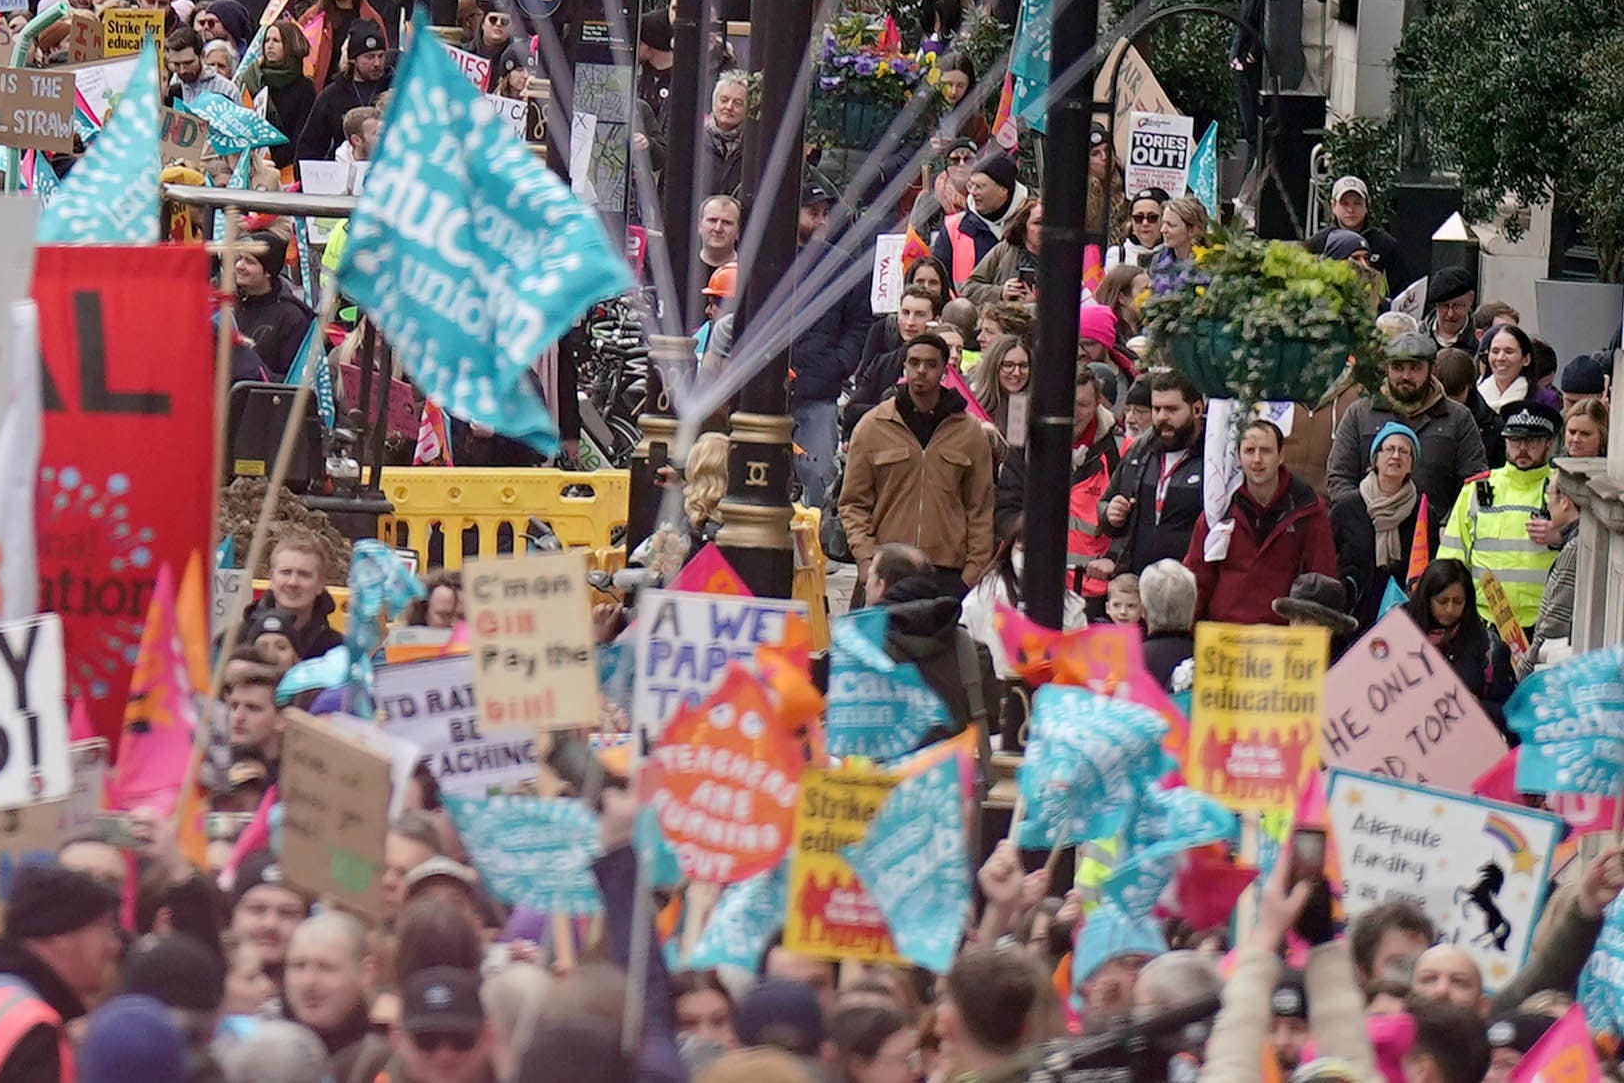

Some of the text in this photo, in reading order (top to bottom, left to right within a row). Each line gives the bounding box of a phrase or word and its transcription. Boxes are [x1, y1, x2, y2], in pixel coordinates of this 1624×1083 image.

[107, 21, 162, 37] Strike for
[0, 71, 18, 93] IS
[31, 74, 64, 99] THE
[1132, 146, 1186, 168] OUT!
[1133, 132, 1187, 150] TORIES
[472, 569, 572, 603] C'mon
[477, 607, 537, 638] Gill
[650, 595, 681, 634] A
[480, 641, 589, 676] Pay the
[1201, 647, 1317, 681] Strike for
[1367, 642, 1436, 716] ONLY
[379, 688, 416, 718] I'D
[499, 688, 555, 722] bill!
[1199, 685, 1316, 717] education
[1405, 690, 1470, 757] TORY
[657, 741, 796, 808] TEACHERS
[690, 785, 751, 820] ARE
[802, 789, 877, 821] Strike
[1351, 811, 1443, 850] Adequate
[680, 850, 735, 881] OUT
[1351, 843, 1426, 884] funding
